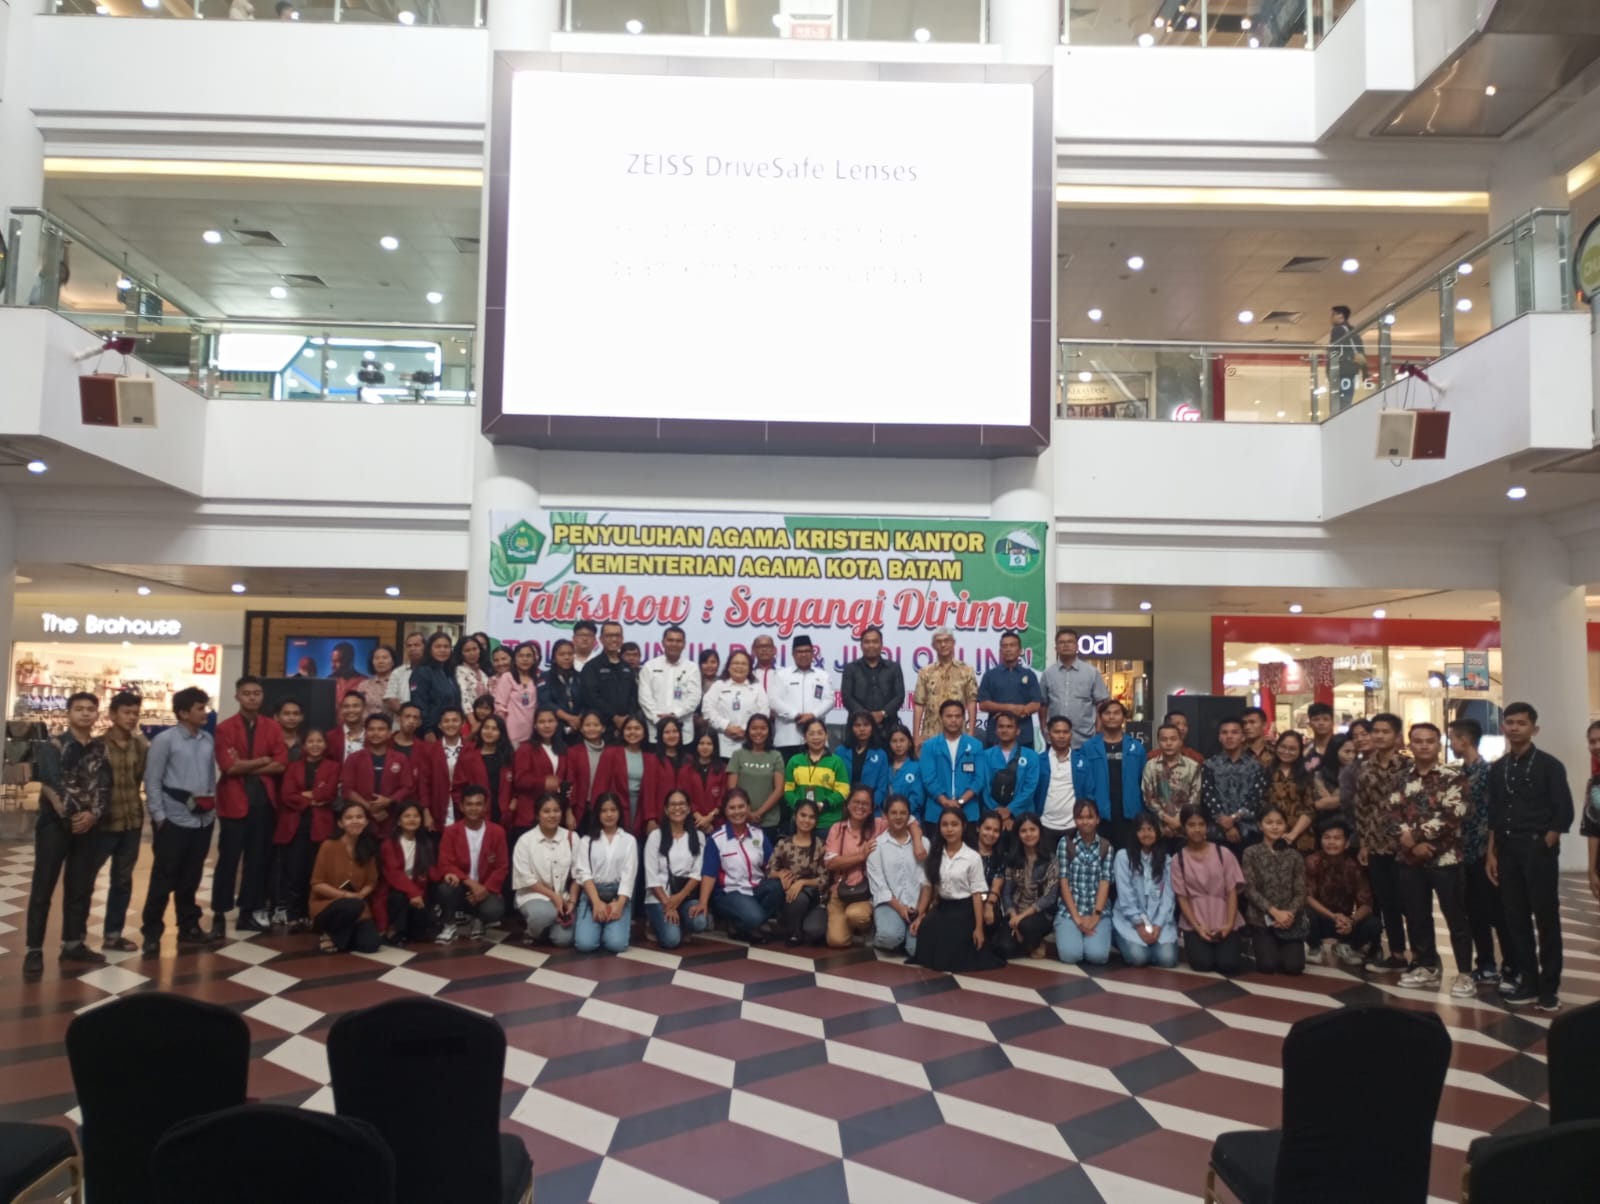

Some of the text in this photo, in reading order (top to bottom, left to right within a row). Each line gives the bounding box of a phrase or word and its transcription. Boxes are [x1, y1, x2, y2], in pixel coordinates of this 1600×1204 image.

[626, 153, 919, 182] ZEISS DriveSafe Lenses
[553, 524, 985, 553] PENYULUHAN AGAMA KRISTEN KANTOR
[574, 553, 963, 581] KEMENTERIAN AGAMA KOTA BATAM
[42, 613, 181, 635] The Brahouse
[507, 581, 690, 624] Talkshow
[724, 585, 887, 639] Sayangi
[895, 588, 1028, 631] Dirimu
[195, 651, 215, 672] 50
